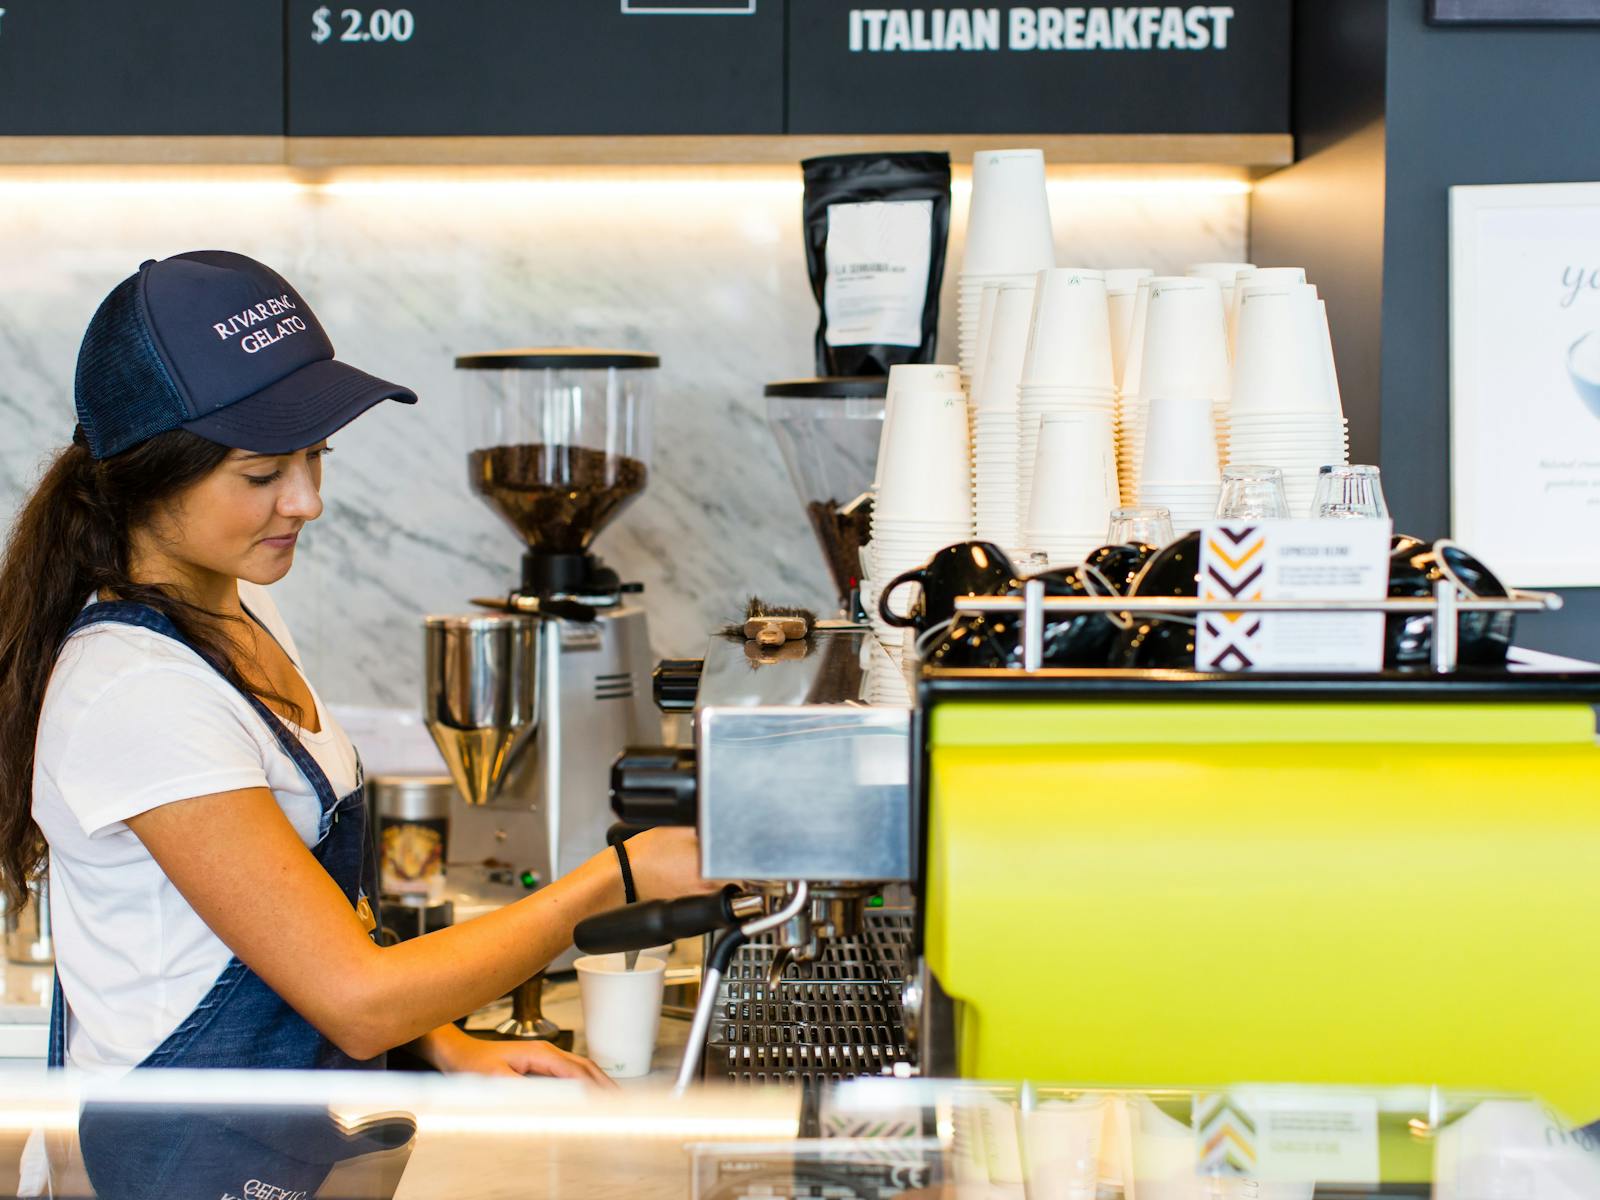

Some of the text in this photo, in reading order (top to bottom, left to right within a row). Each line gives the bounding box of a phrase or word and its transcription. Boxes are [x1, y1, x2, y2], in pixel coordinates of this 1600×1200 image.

[311, 5, 414, 44] $ 2.00
[849, 6, 1234, 51] ITALIAN BREAKFAST
[241, 315, 306, 353] GELATO
